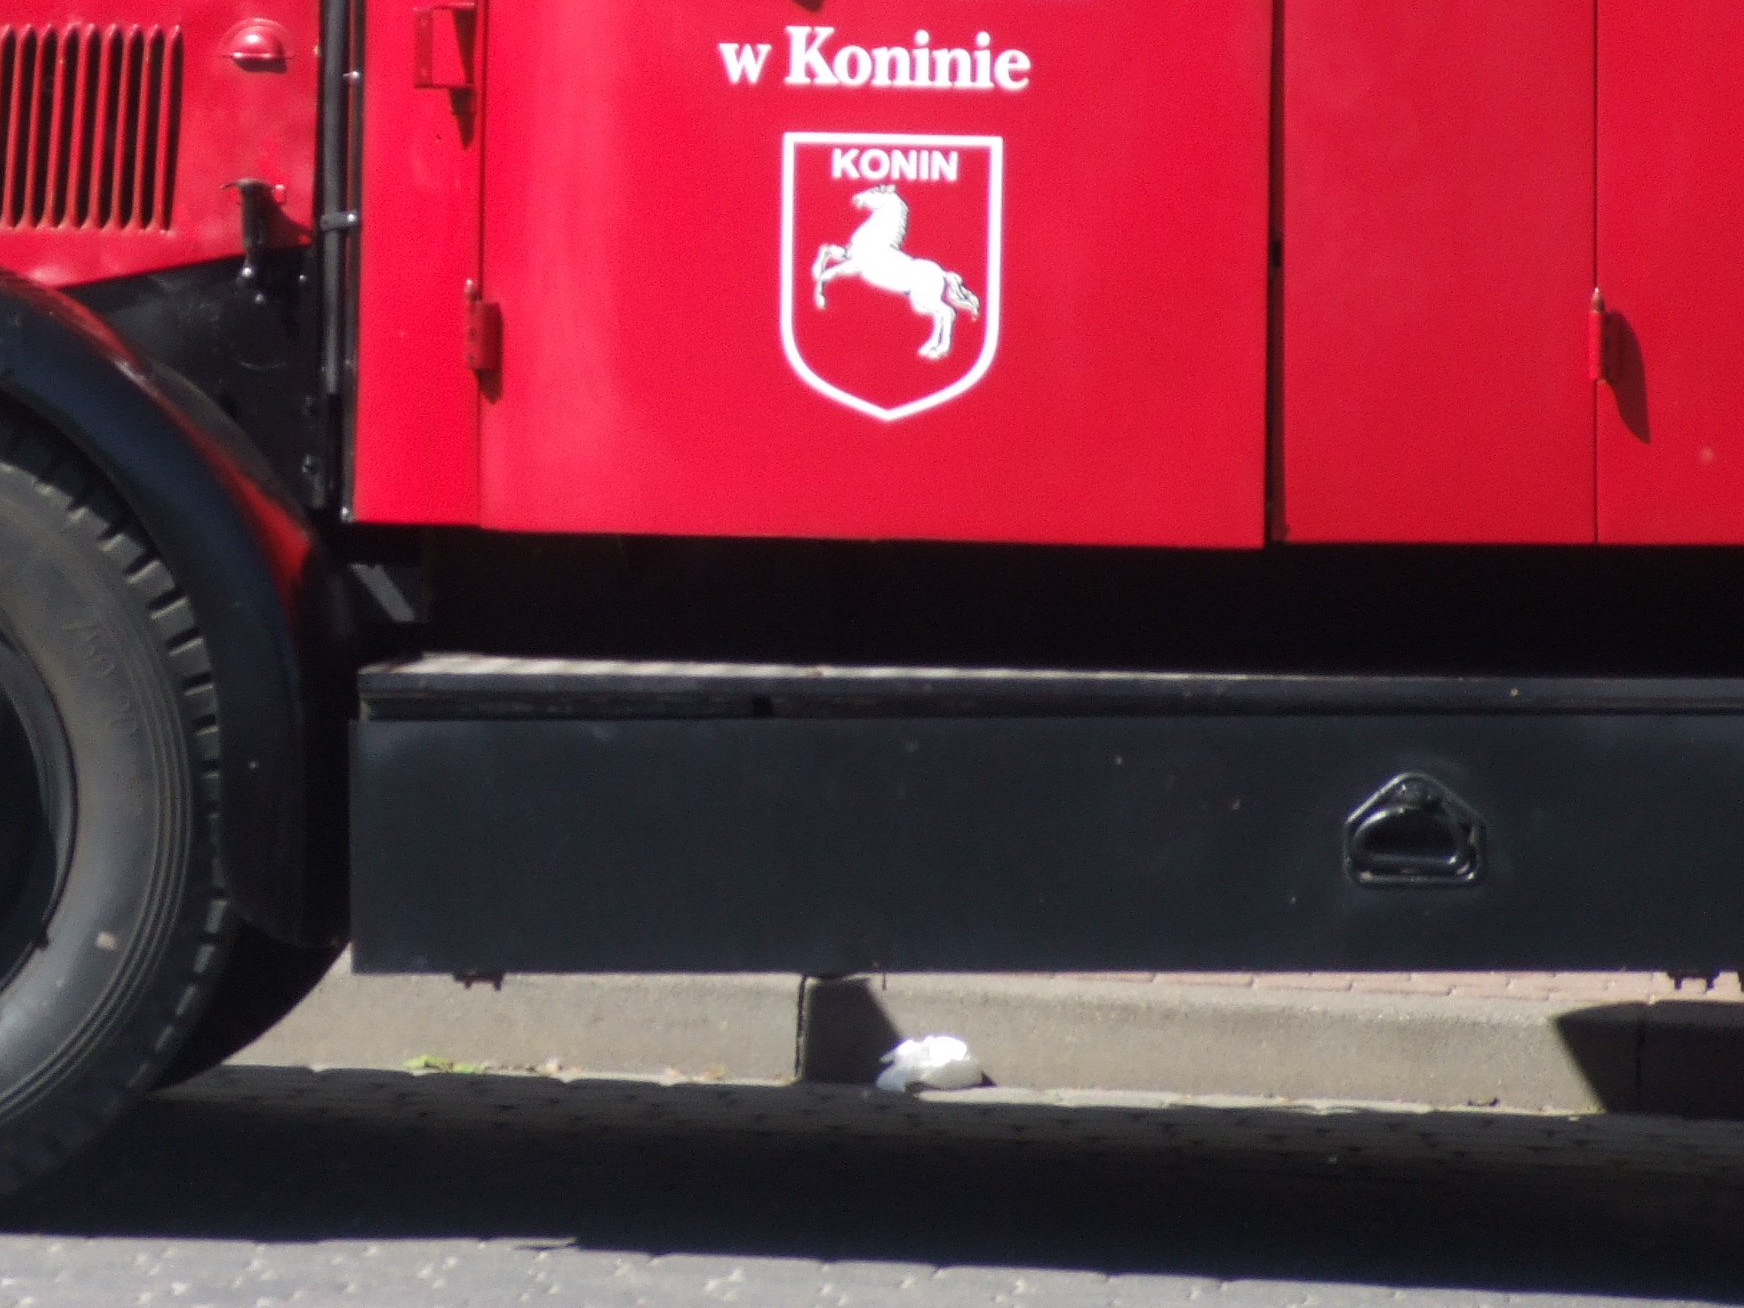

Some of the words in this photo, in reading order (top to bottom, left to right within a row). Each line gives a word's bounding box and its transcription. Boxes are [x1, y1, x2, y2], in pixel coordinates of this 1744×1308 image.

[718, 42, 772, 84] w
[785, 26, 1031, 90] Koninie
[831, 148, 958, 181] KONIN
